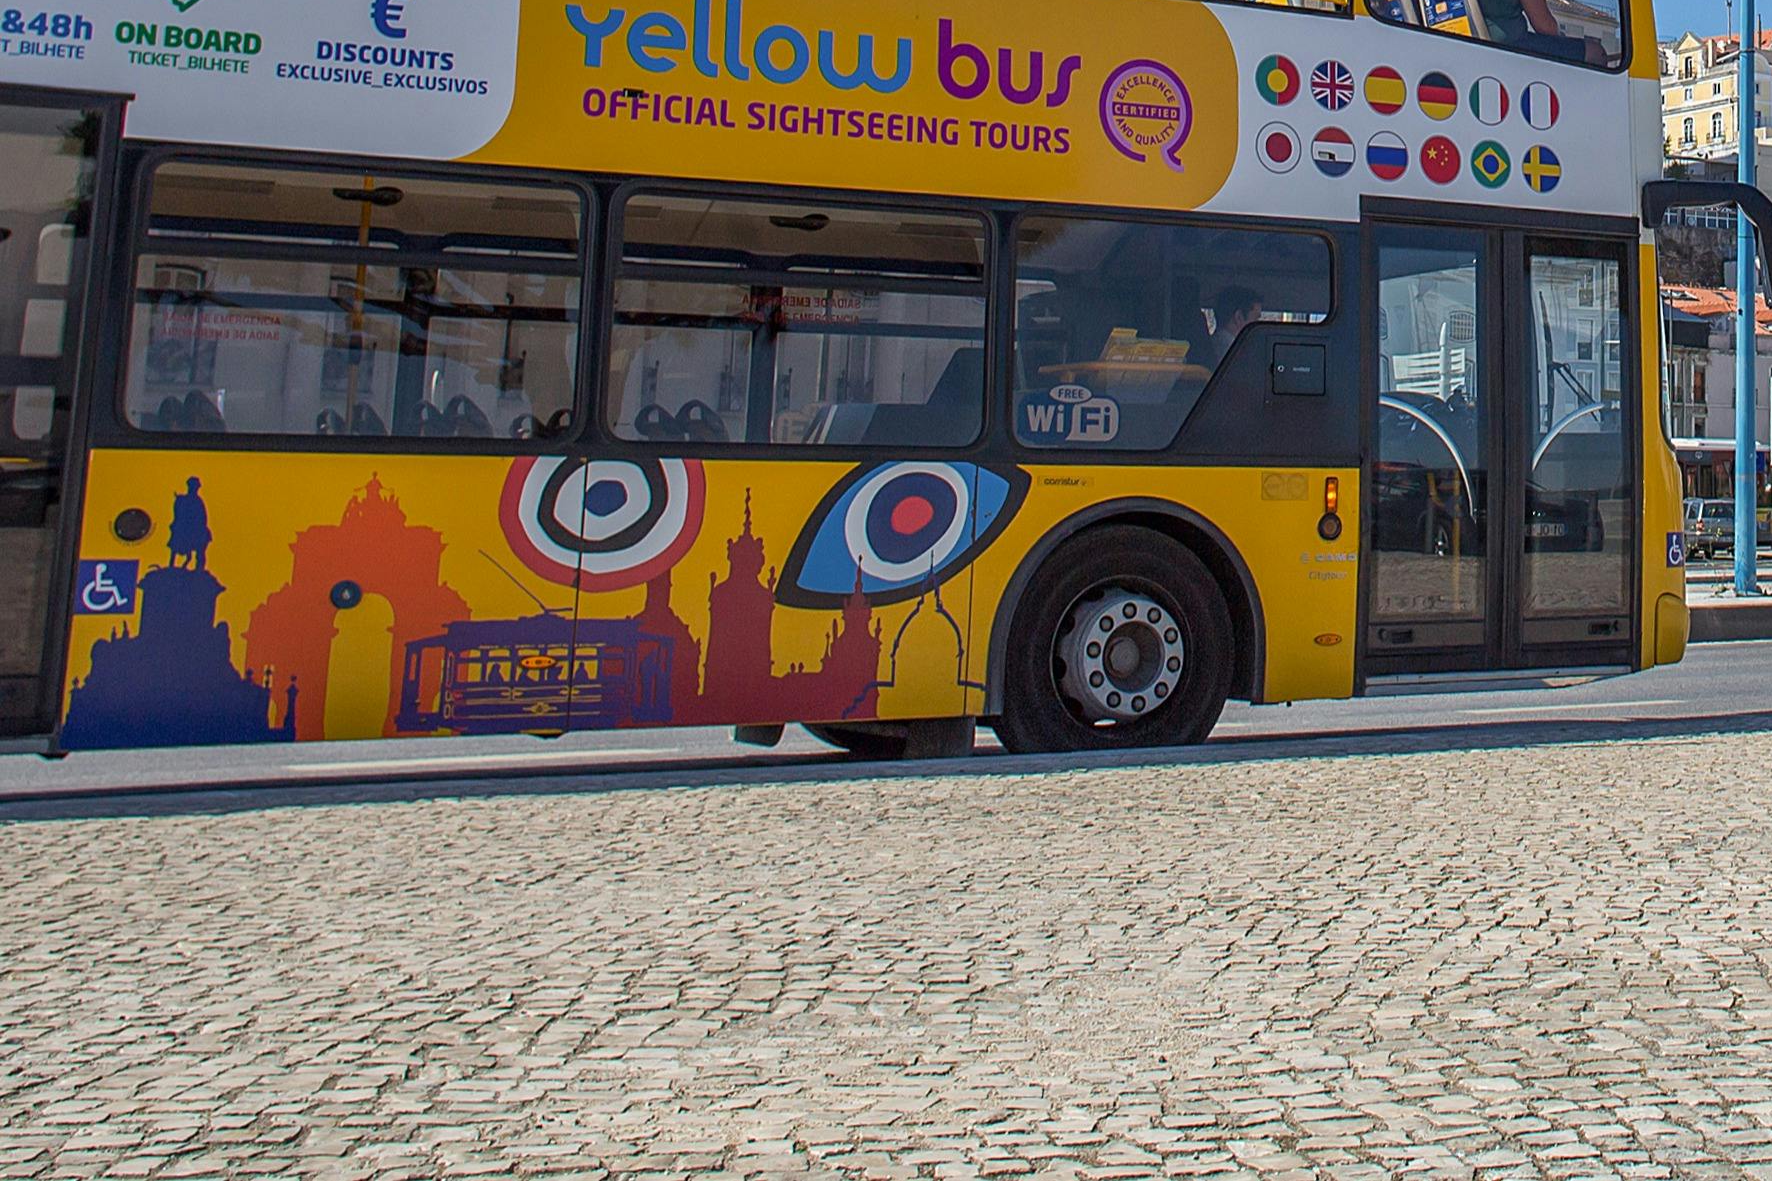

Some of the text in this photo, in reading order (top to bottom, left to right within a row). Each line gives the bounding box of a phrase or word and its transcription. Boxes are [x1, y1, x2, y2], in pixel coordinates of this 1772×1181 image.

[115, 20, 262, 55] ON BOARD
[128, 50, 250, 74] TICKET_BILHETE
[316, 40, 454, 71] DISCOUNTS
[938, 19, 1081, 108] bus
[276, 62, 488, 96] EXCLUSIVE_EXCLUSIVOS
[1117, 75, 1175, 103] EXCELLENCE
[582, 88, 1071, 155] OFFICIAL SIGHTSEEING TOURS
[1114, 104, 1178, 119] CERTIFIED
[1116, 118, 1175, 146] AND QUALITY
[1057, 388, 1084, 399] FREE
